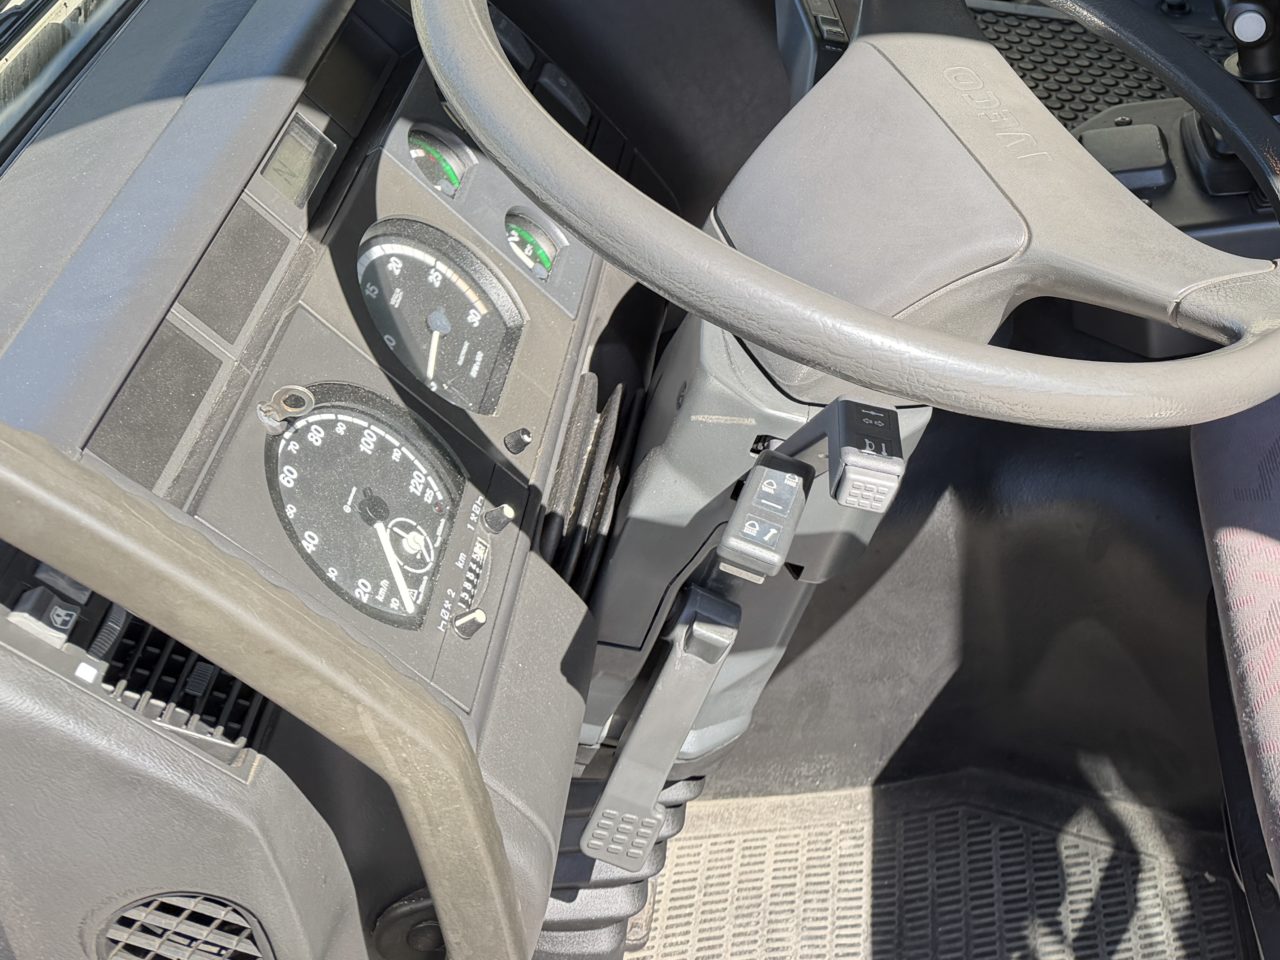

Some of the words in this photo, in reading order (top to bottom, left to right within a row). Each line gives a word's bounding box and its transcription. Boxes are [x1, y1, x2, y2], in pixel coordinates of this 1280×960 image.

[387, 256, 403, 276] 20
[427, 268, 443, 288] 25
[365, 282, 379, 300] 15
[466, 308, 482, 328] 30
[307, 424, 325, 447] 80
[359, 429, 377, 455] 100
[287, 441, 300, 455] 70
[279, 465, 298, 488] 60
[409, 470, 425, 496] 120
[301, 531, 319, 554] 40
[455, 552, 467, 569] km
[355, 578, 371, 603] 20
[375, 578, 390, 602] km/h
[390, 598, 400, 611] 10
